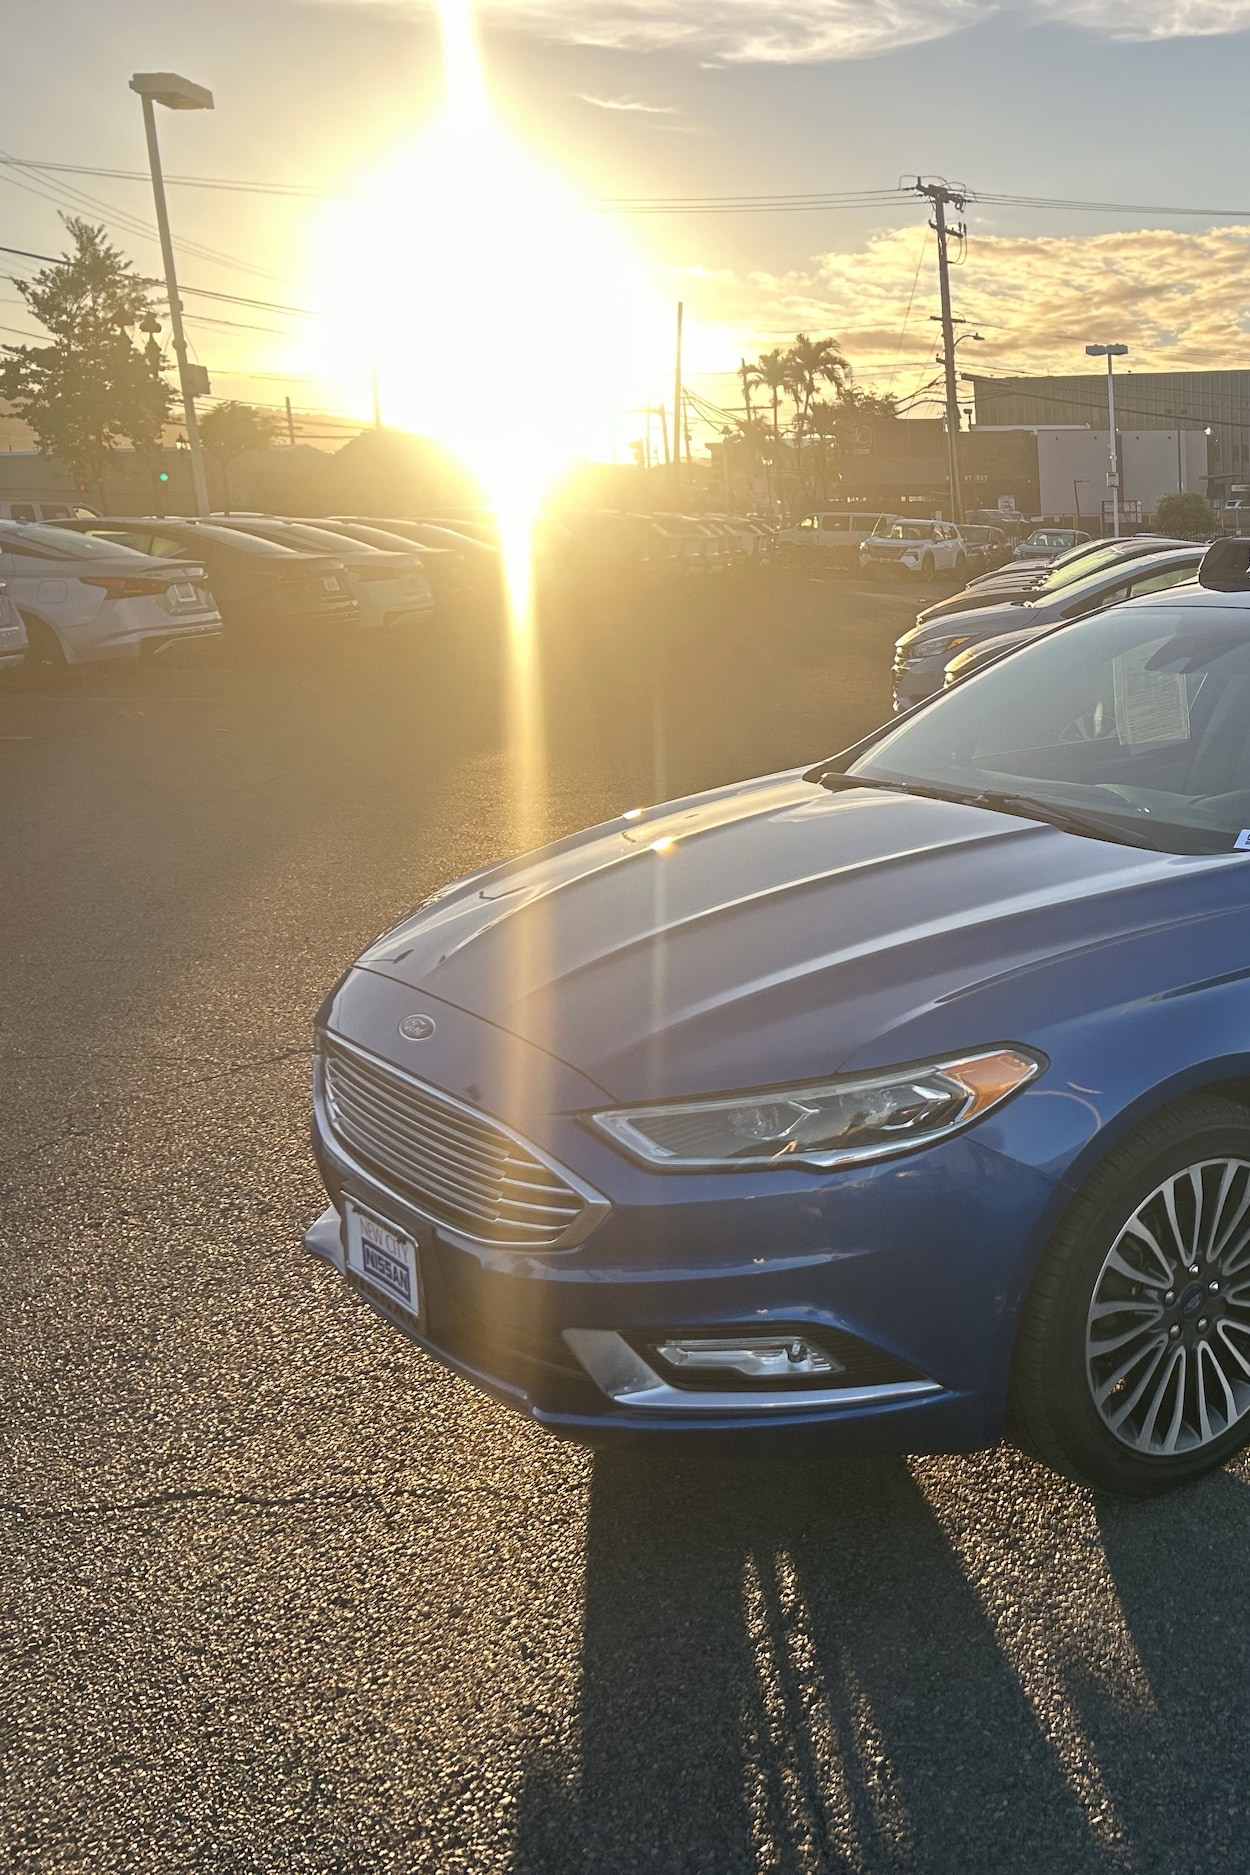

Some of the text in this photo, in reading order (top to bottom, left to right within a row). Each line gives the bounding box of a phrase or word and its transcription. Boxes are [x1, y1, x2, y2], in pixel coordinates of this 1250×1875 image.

[360, 1218, 408, 1263] NEW CITY
[365, 1247, 408, 1291] NISSAN
